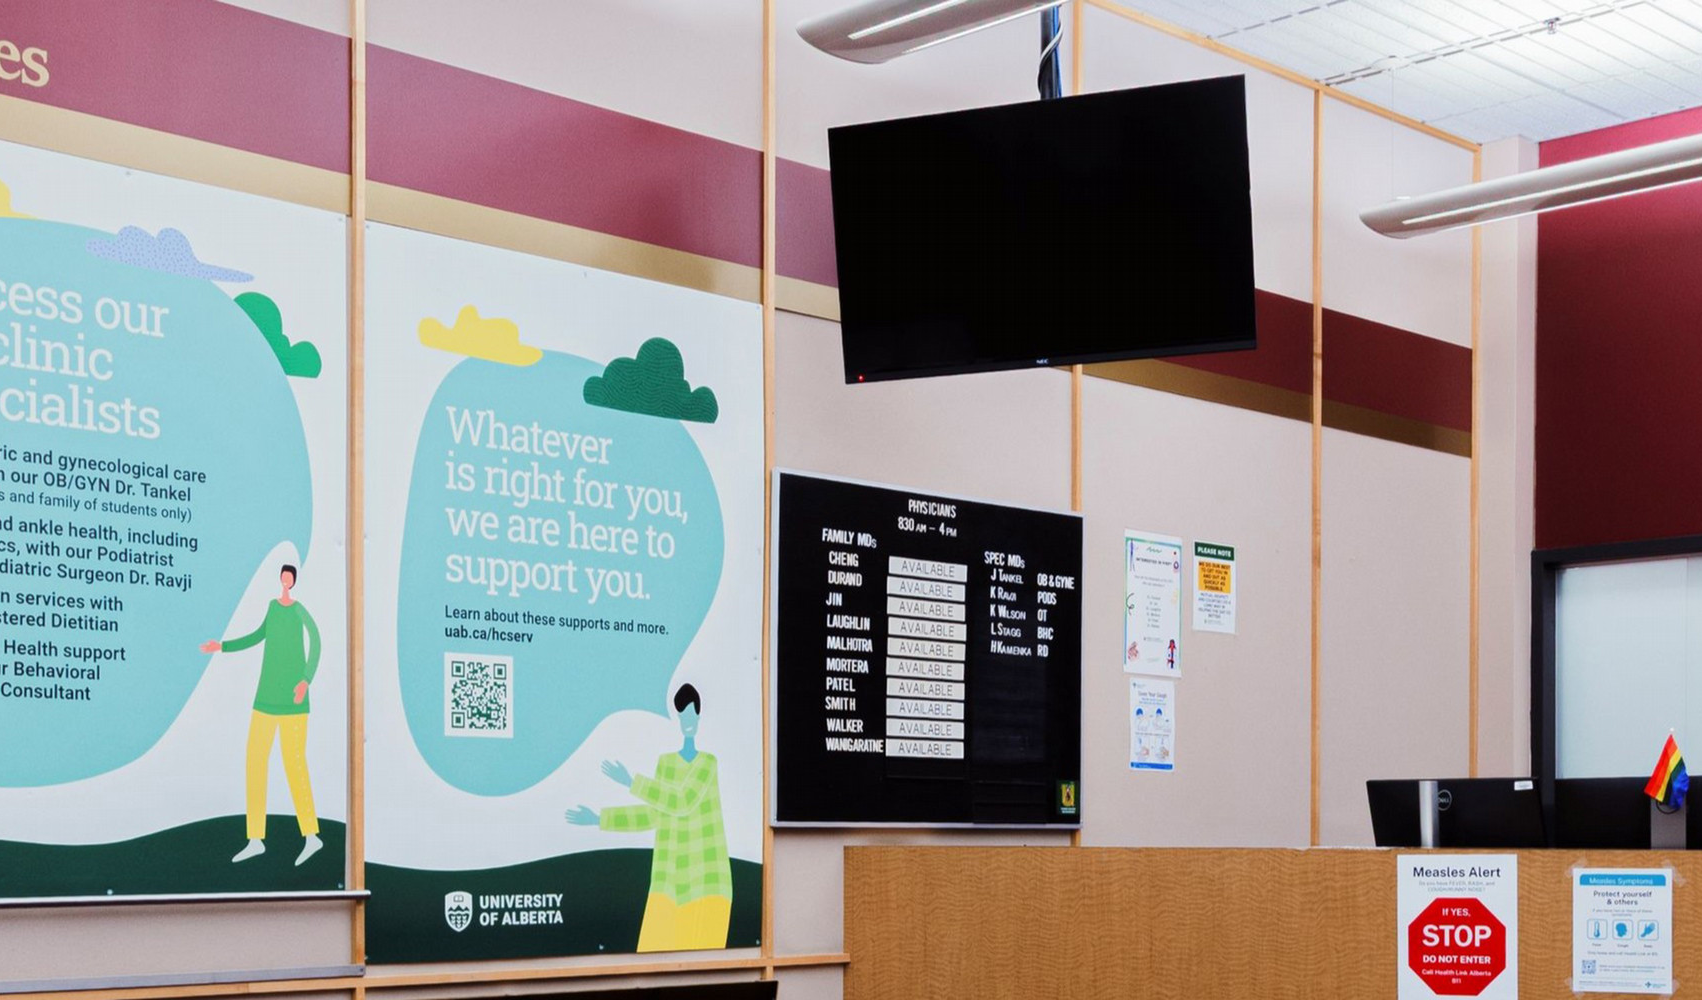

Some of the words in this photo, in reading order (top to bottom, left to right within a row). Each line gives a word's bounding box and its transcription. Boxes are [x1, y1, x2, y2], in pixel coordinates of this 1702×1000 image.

[94, 296, 169, 338] our
[446, 406, 612, 464] Whatever
[23, 450, 52, 465] and
[58, 456, 168, 479] gynecological
[174, 470, 206, 483] care
[445, 451, 475, 492] is
[484, 459, 566, 509] right
[573, 469, 618, 509] for
[625, 485, 687, 524] you,
[10, 491, 34, 504] and
[39, 492, 80, 511] family
[84, 498, 97, 510] of
[102, 501, 157, 517] students
[161, 507, 191, 523] only)
[909, 499, 956, 518] PHYSICIANS
[445, 507, 499, 541] we
[507, 515, 560, 546] are
[568, 512, 639, 555] here
[646, 526, 675, 559] to
[898, 516, 914, 531] 830
[915, 524, 926, 532] AM
[939, 522, 945, 535] 4
[946, 528, 957, 536] PM
[822, 528, 854, 544] FAMILY
[829, 551, 858, 566] CHENG
[984, 551, 1005, 566] SPEC
[1197, 547, 1216, 555] PLEASE
[1218, 549, 1231, 557] NOTE
[902, 561, 955, 578] AVAILABLE
[446, 554, 578, 598] support
[585, 567, 650, 604] you.
[828, 570, 862, 586] DURAND
[1037, 573, 1047, 587] OB
[1049, 575, 1054, 588] &
[1055, 575, 1075, 590] GYNE
[900, 581, 953, 598] AVAILABLE
[826, 592, 842, 606] JIN
[1037, 591, 1057, 605] PODS
[445, 605, 480, 620] Learn
[484, 608, 519, 623] about
[523, 611, 555, 626] these
[559, 617, 610, 631] supports
[614, 620, 633, 632] and
[637, 623, 668, 634] more.
[990, 604, 996, 617] K
[1037, 609, 1047, 622] OT
[827, 614, 870, 630] LAUGHLIN
[445, 625, 533, 642] uab.ca/hcserv
[991, 622, 996, 635] L
[1037, 626, 1054, 640] BHC
[827, 636, 873, 652] MALHOTRA
[1037, 644, 1048, 657] RD
[826, 658, 869, 674] MORTERA
[1, 682, 90, 700] Consultant
[826, 677, 855, 692] PATEL
[825, 696, 855, 711] SMITH
[826, 718, 863, 732] WALKER
[899, 742, 951, 756] AVAILABLE
[1413, 867, 1465, 878] Measles
[1469, 867, 1501, 878] Alert
[479, 894, 563, 909] UNIVERSITY
[479, 912, 498, 926] OF
[502, 910, 563, 925] ALBERTA
[1442, 908, 1449, 916] If
[1422, 924, 1492, 948] STOP
[1423, 955, 1436, 963] DO
[1438, 955, 1458, 964] NOT
[1460, 955, 1491, 964] ENTER
